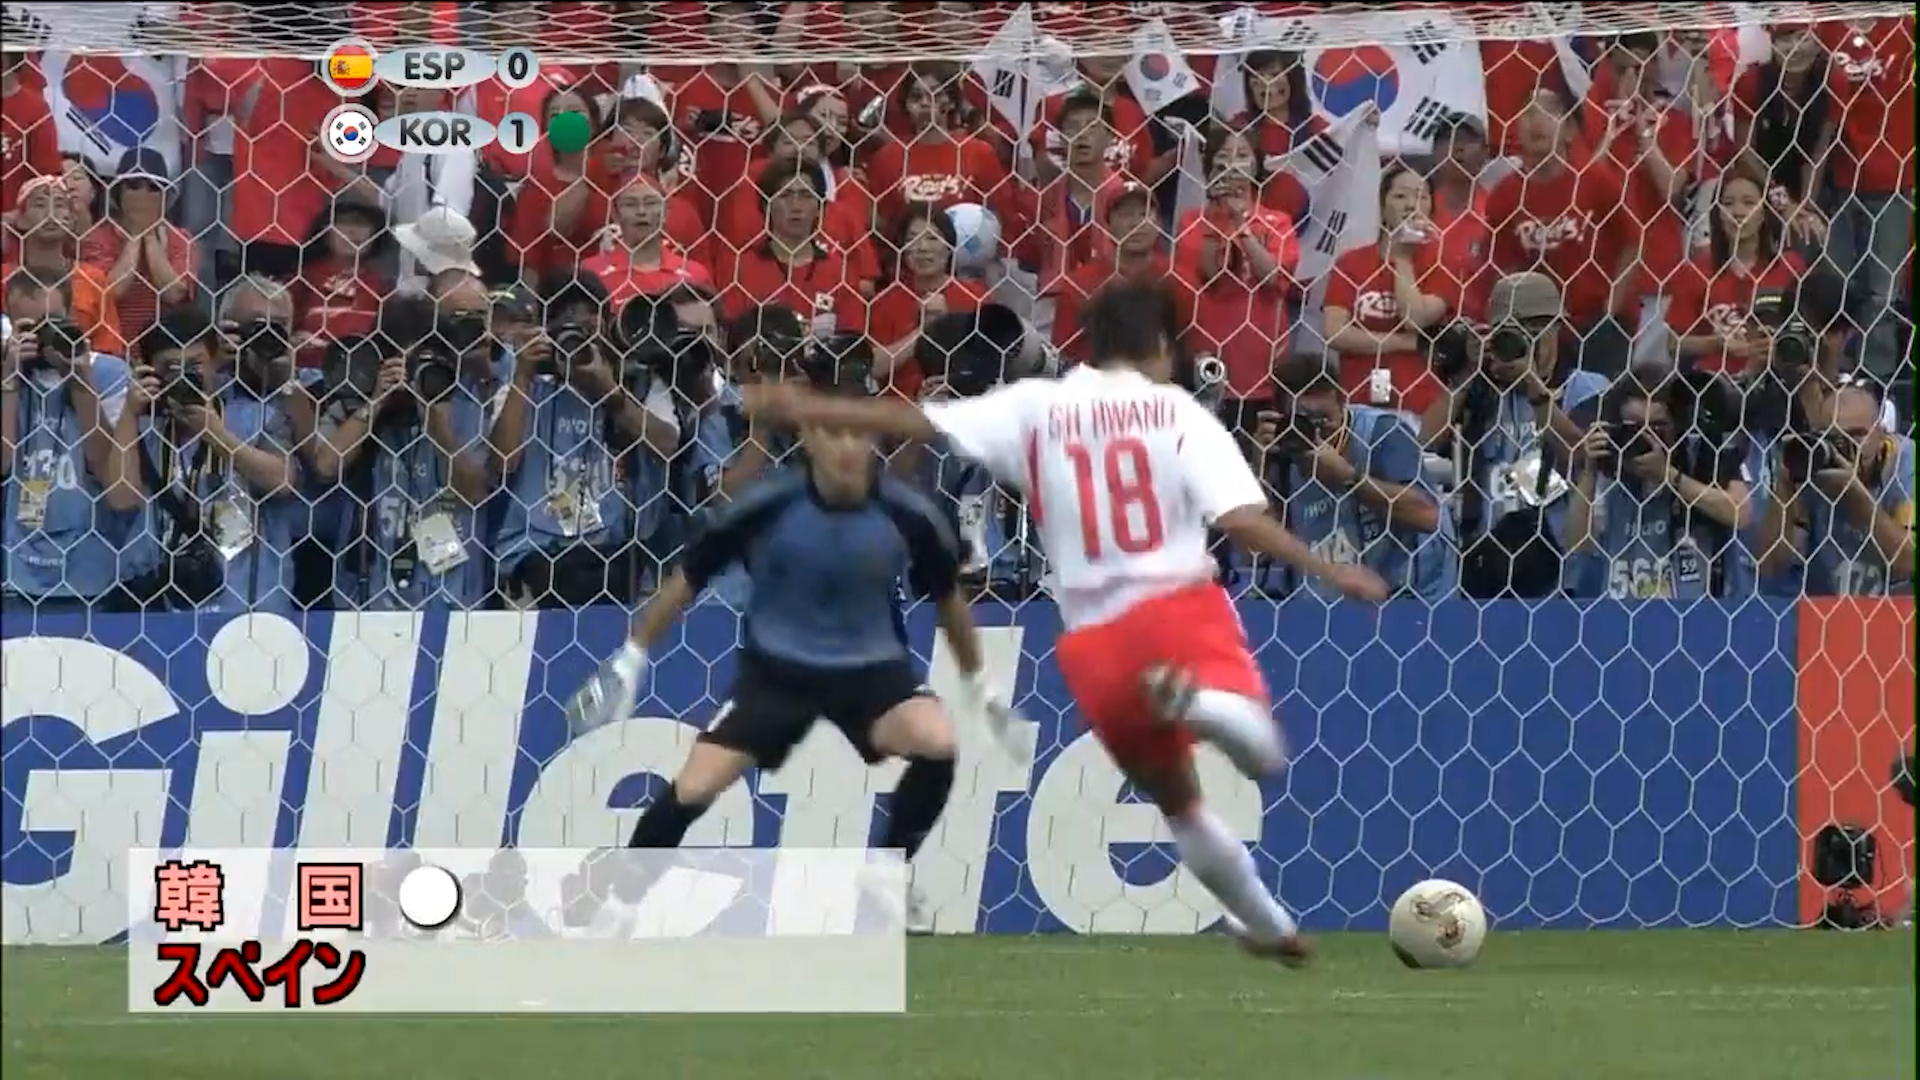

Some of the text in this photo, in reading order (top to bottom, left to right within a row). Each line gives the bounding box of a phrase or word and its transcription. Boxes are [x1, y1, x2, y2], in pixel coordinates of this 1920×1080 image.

[1064, 436, 1165, 564] 18
[1681, 559, 1698, 575] 59
[2, 608, 1264, 944] Gillette
